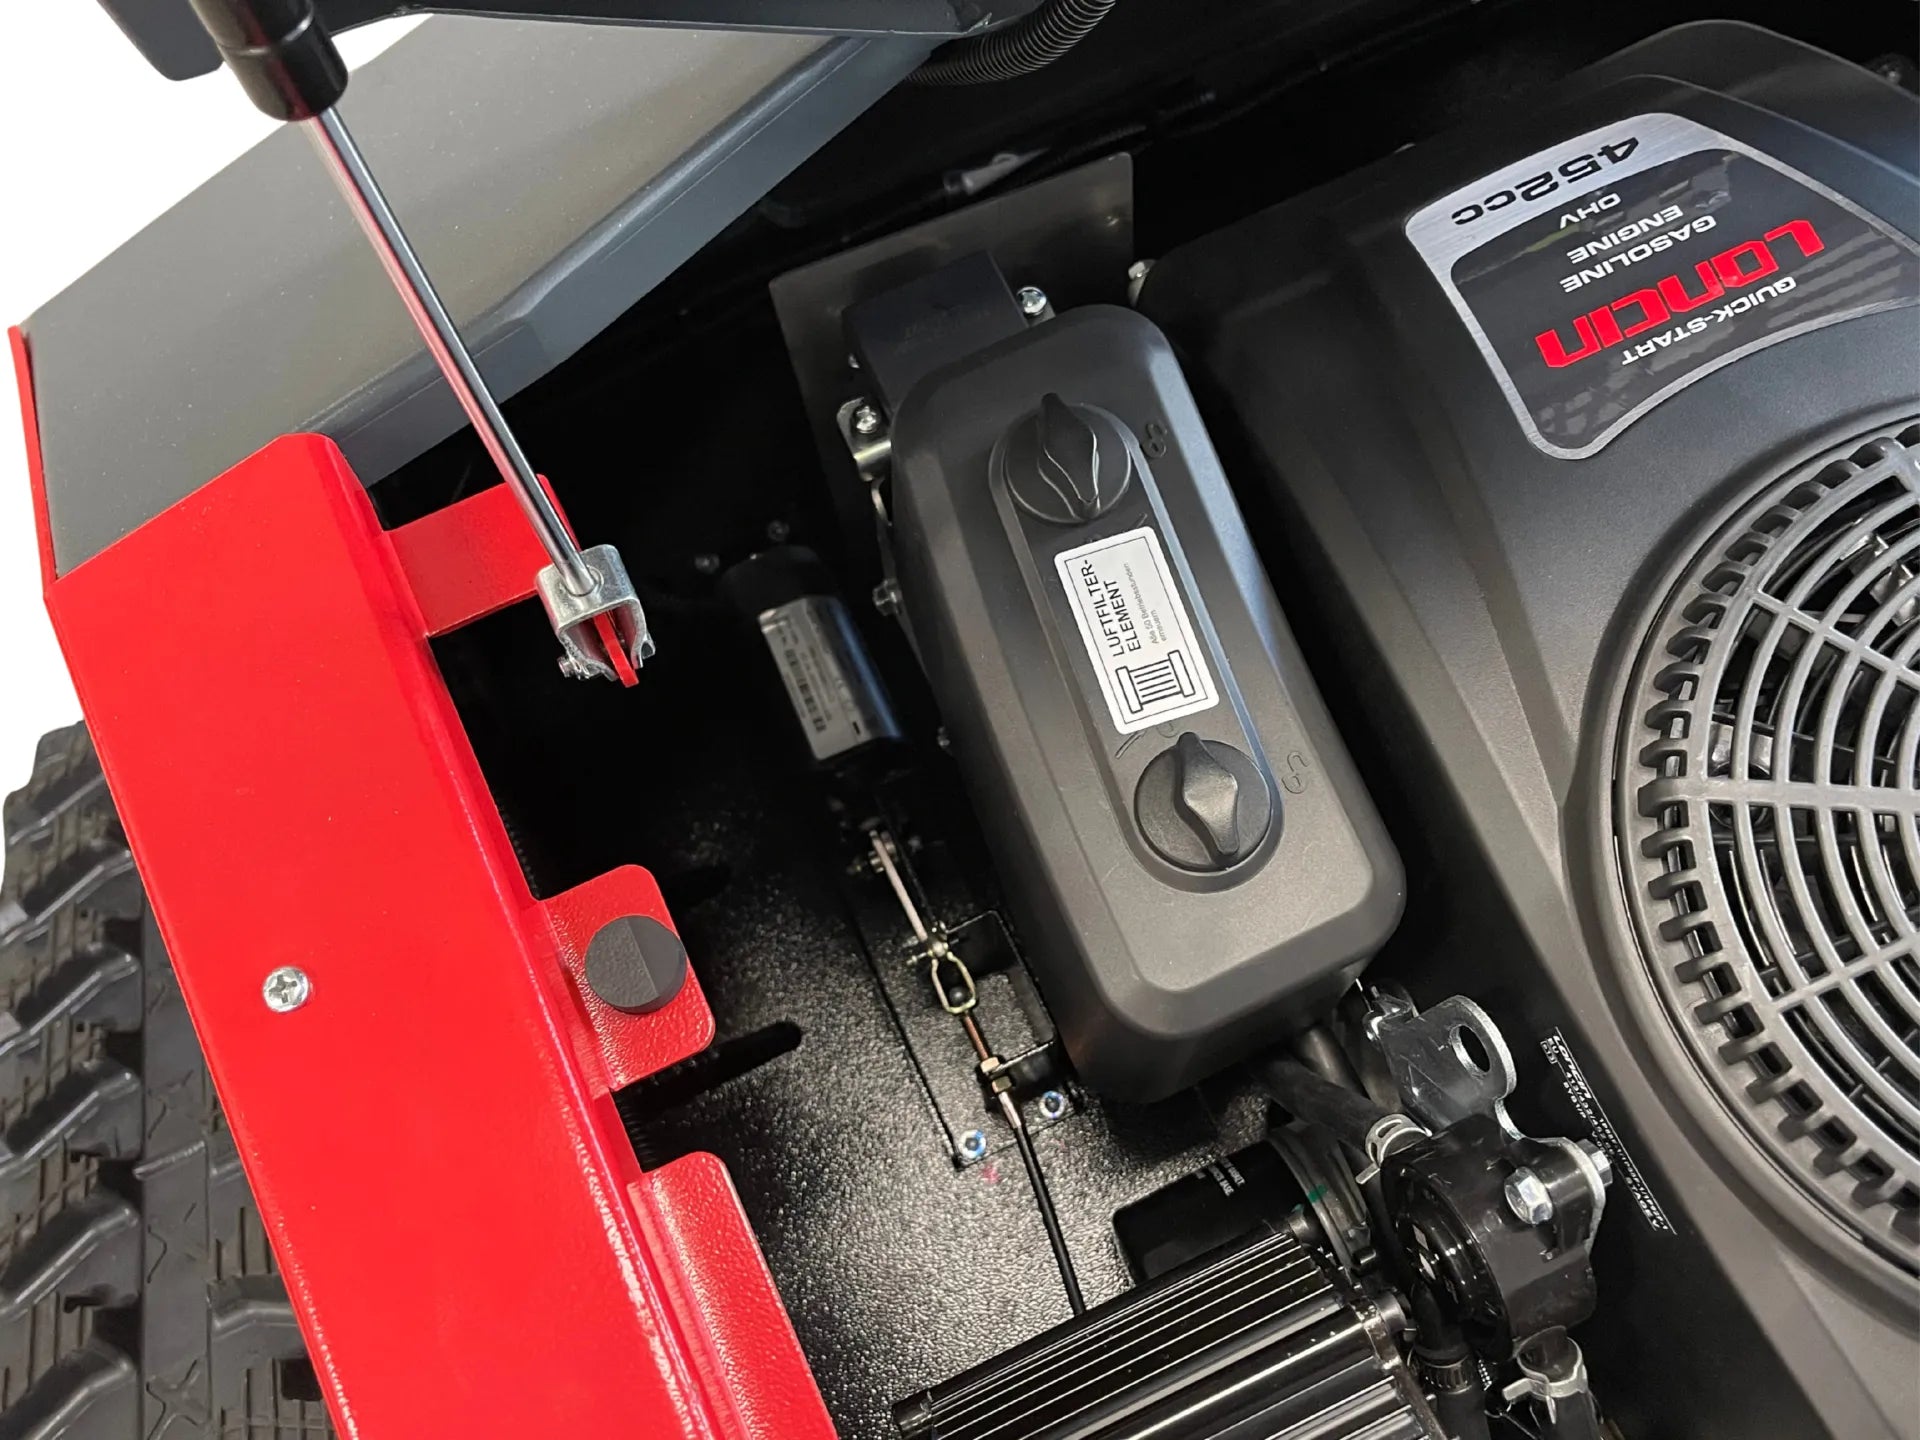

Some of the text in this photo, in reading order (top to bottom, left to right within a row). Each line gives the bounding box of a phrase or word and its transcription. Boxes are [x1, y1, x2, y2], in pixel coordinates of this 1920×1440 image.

[1451, 137, 1639, 226] 452cc
[1560, 192, 1621, 230] OHV
[1560, 215, 1717, 293] GASOLINE
[1566, 205, 1684, 264] ENGINE
[1621, 276, 1797, 366] QUICK-START
[1081, 559, 1125, 657] LUFTFILTER-
[1104, 580, 1141, 652] ELEMENT
